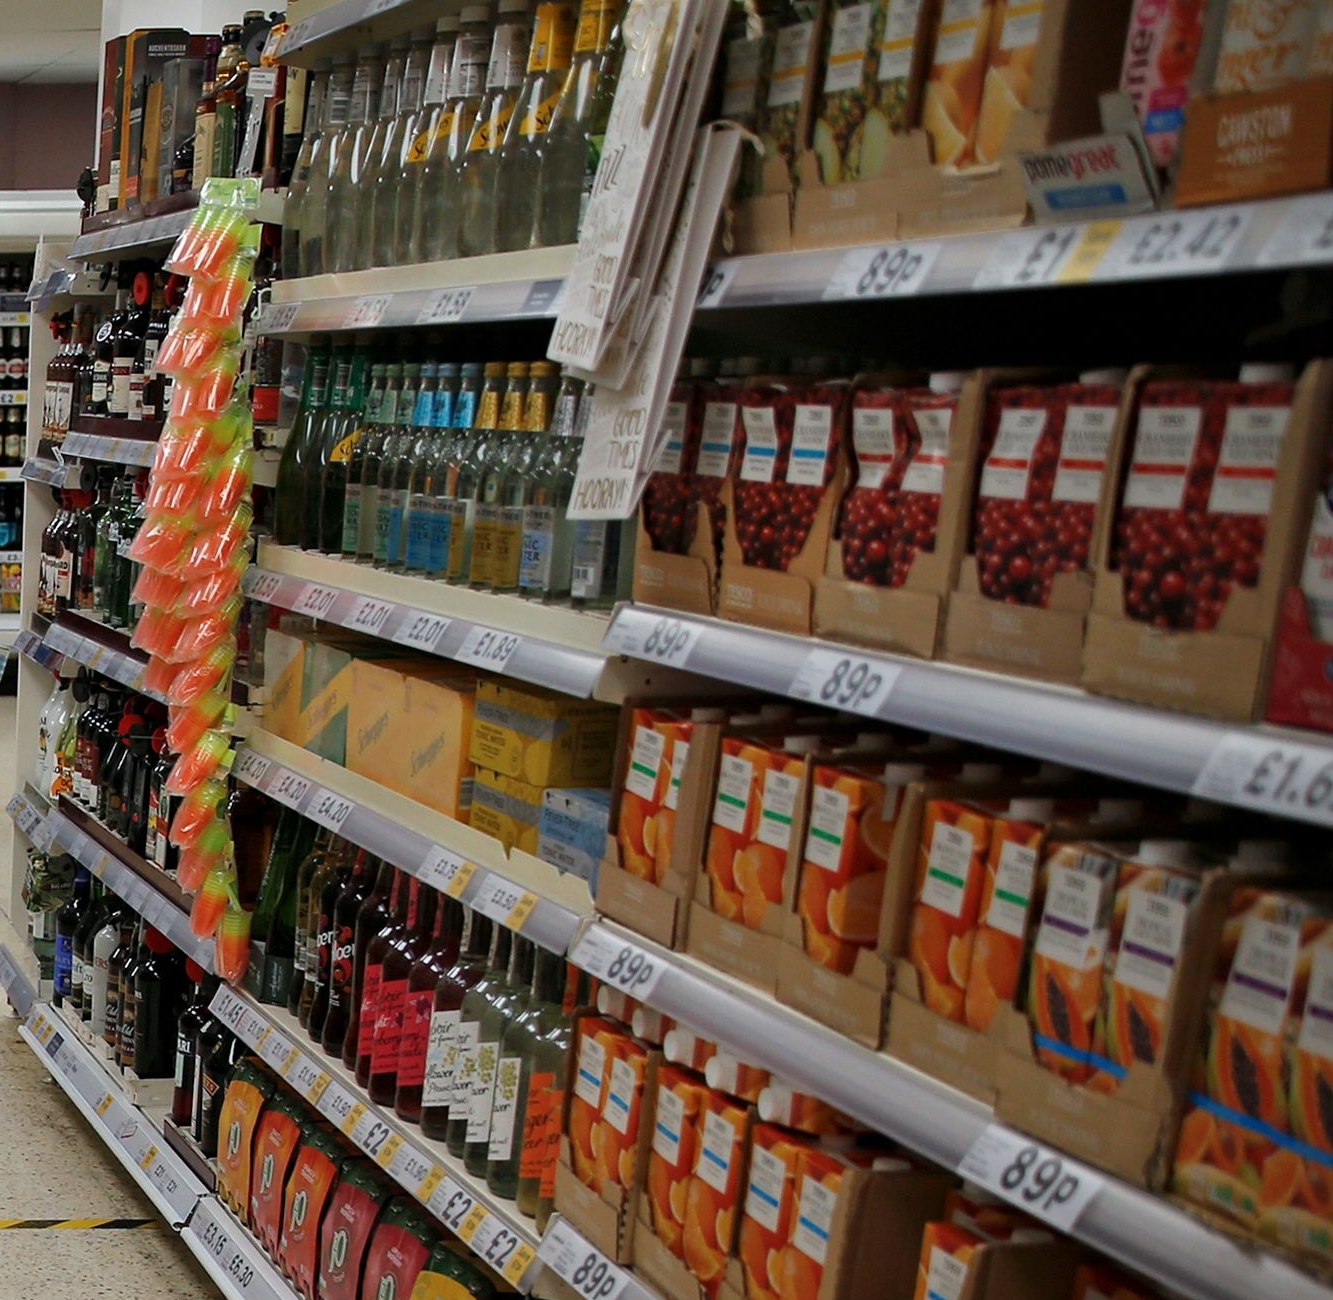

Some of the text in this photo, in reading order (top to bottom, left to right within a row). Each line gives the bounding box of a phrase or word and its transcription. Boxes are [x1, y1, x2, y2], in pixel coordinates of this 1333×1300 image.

[1013, 229, 1077, 283] £1
[1128, 215, 1242, 265] £2.42
[852, 248, 925, 295] 89p
[355, 603, 389, 629] £2.01
[408, 615, 447, 643] £2.01
[471, 629, 518, 662] £1.89
[642, 615, 692, 665] 89p
[817, 656, 884, 714] 89p
[357, 712, 390, 755] Schweppes
[241, 754, 267, 777] £4.20
[1243, 749, 1333, 811] £1.6
[280, 775, 307, 802] £4.20
[317, 793, 349, 823] £4.20
[604, 949, 659, 990] 89p
[217, 994, 240, 1025] £1.45
[364, 1120, 390, 1156] £2
[1000, 1146, 1081, 1215] 89p
[443, 1190, 470, 1229] £2
[203, 1222, 228, 1255] £3.15
[485, 1228, 517, 1268] £2
[228, 1252, 254, 1288] £6.30
